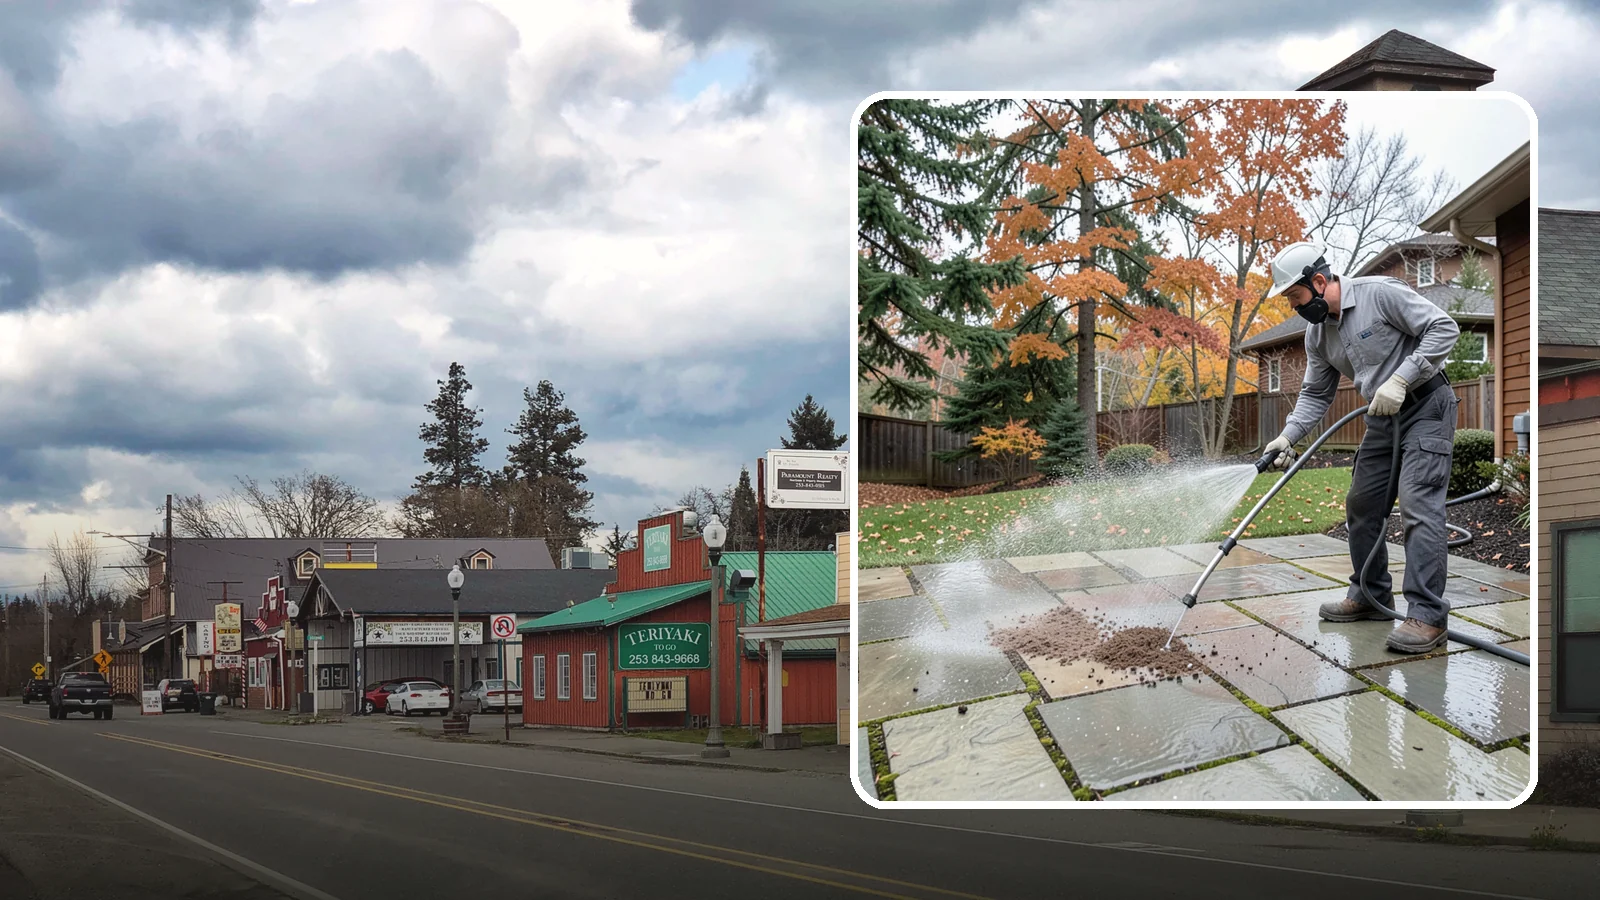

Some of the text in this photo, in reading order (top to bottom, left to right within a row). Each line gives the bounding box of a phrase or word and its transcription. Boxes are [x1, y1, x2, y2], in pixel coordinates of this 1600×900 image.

[781, 471, 815, 479] PARAMOUNT
[624, 627, 702, 646] TERIYAKI
[654, 643, 676, 651] TO GO
[628, 653, 700, 665] 253 843-9668
